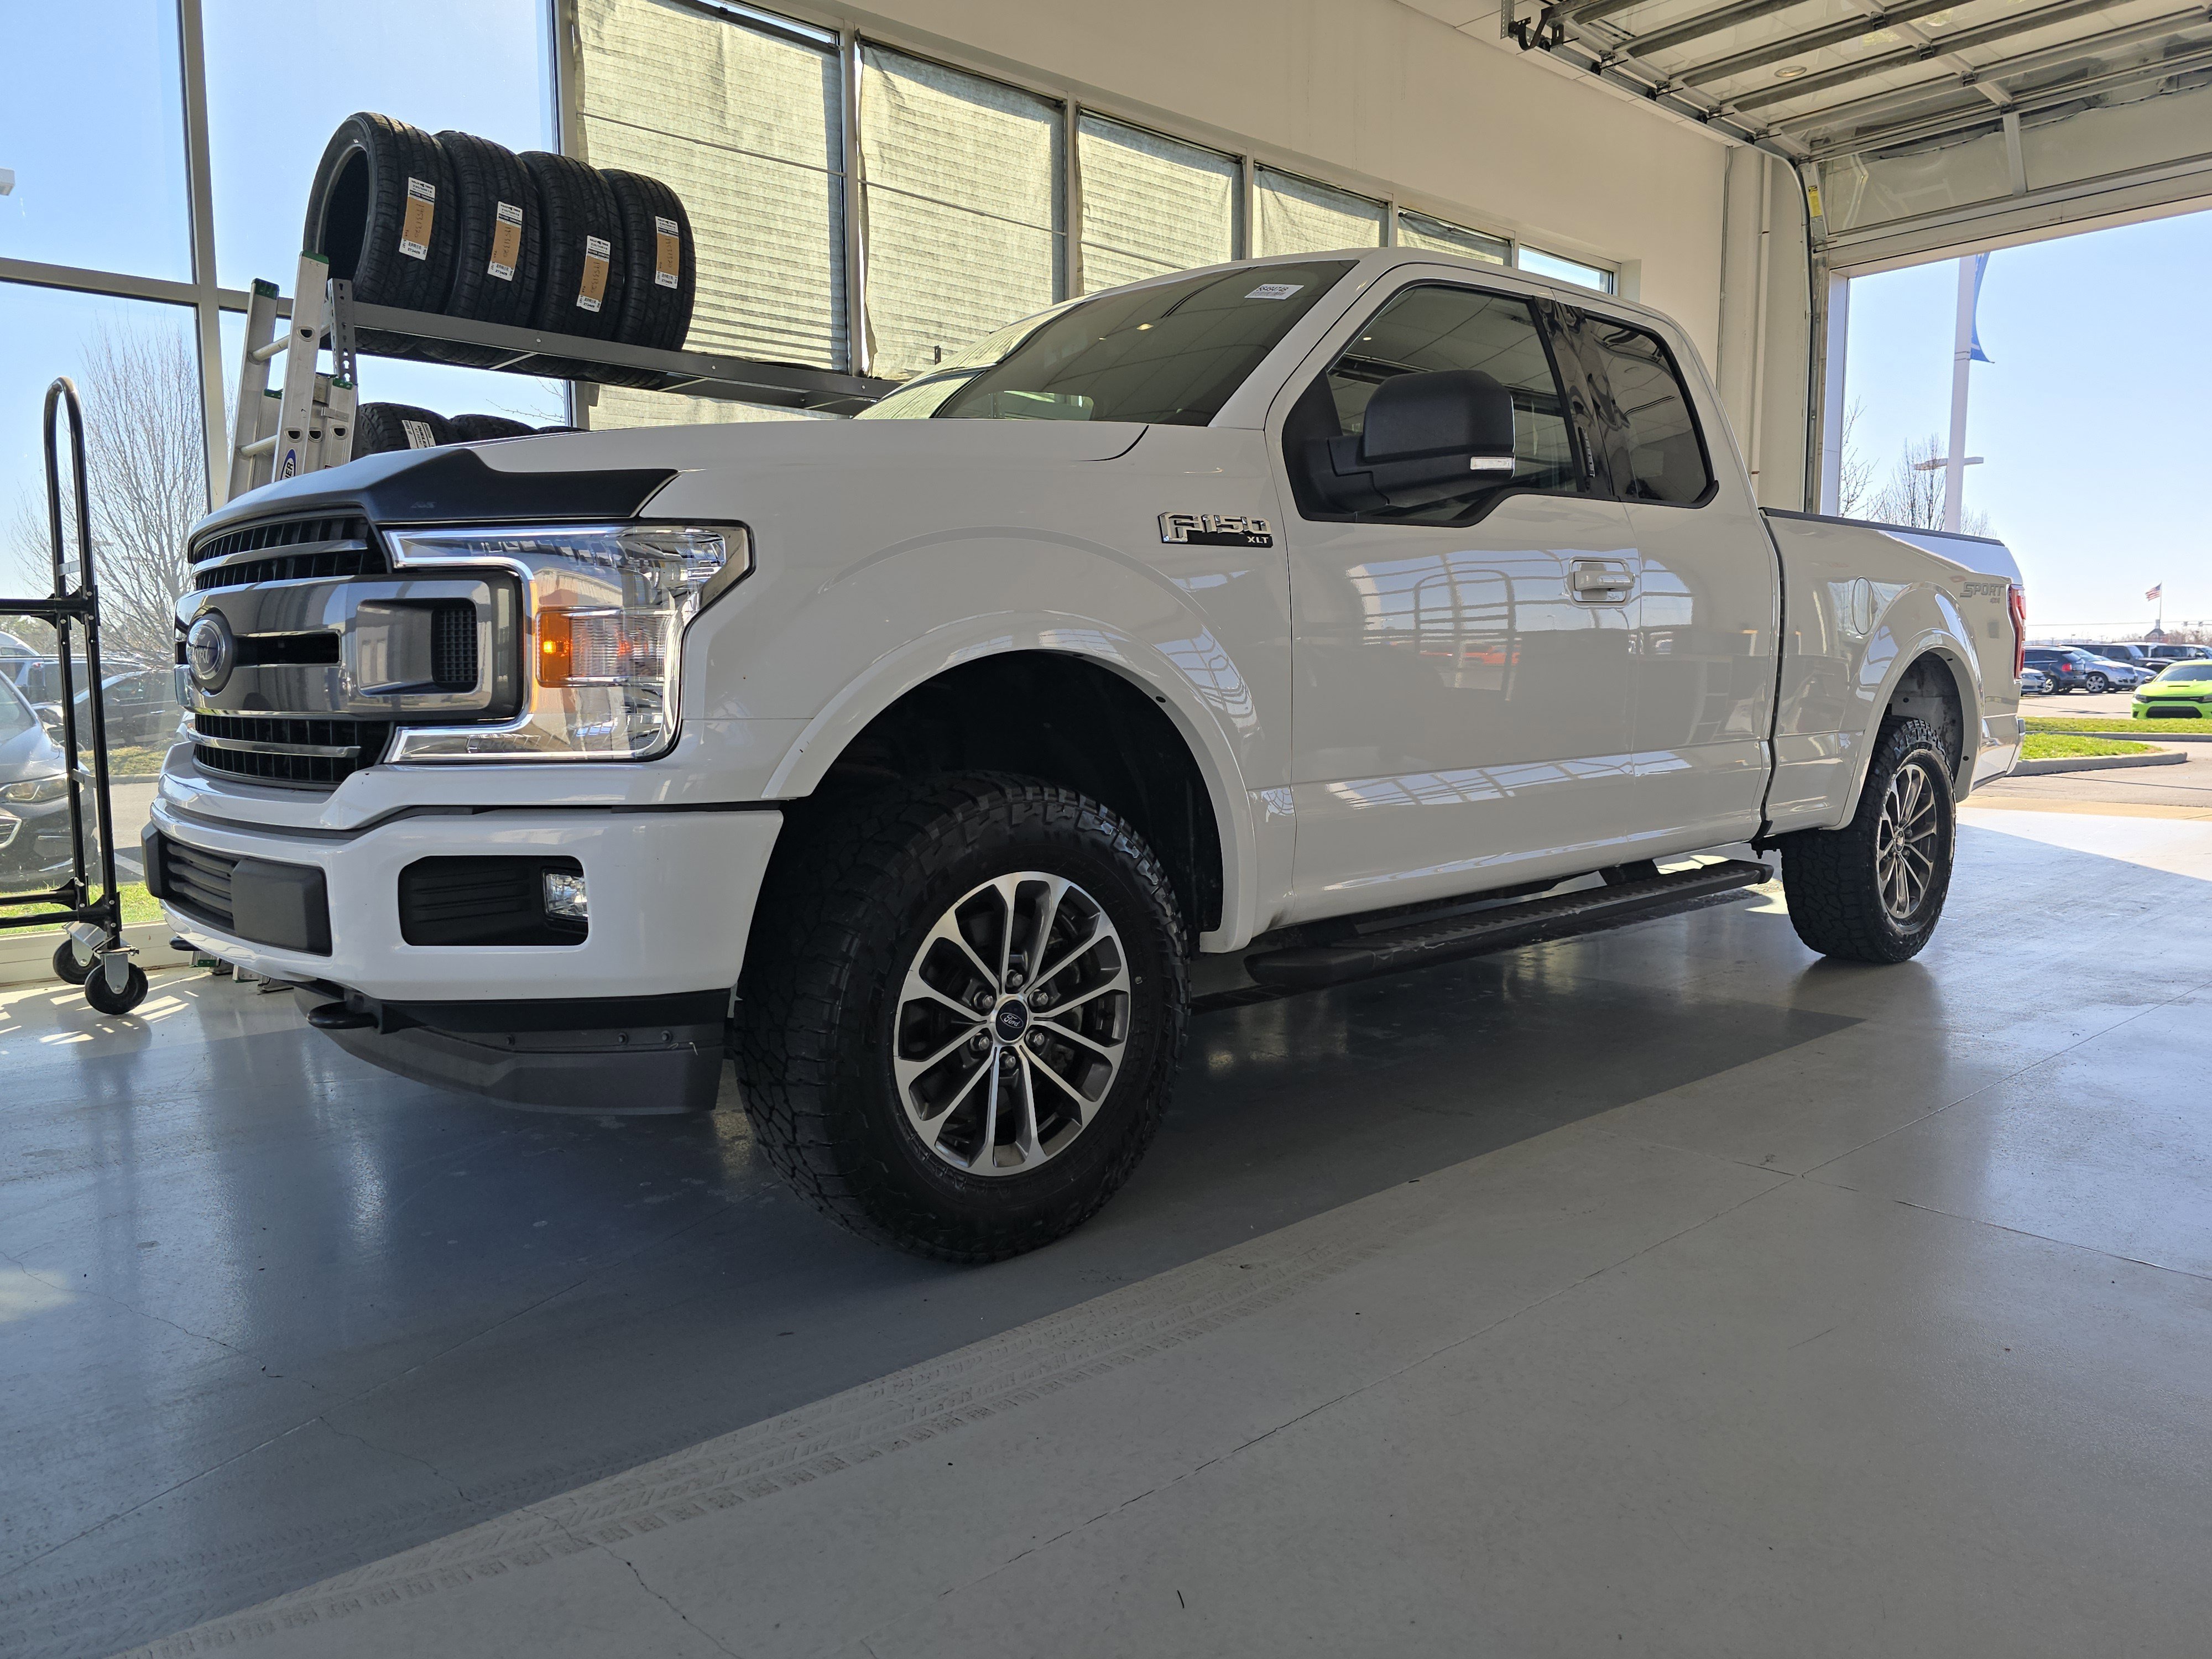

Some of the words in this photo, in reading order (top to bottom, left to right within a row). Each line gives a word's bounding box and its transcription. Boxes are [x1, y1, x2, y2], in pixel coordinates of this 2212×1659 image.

[1247, 535, 1269, 544] XLT
[1959, 582, 2005, 598] SPORT
[1004, 1014, 1021, 1027] Ford
